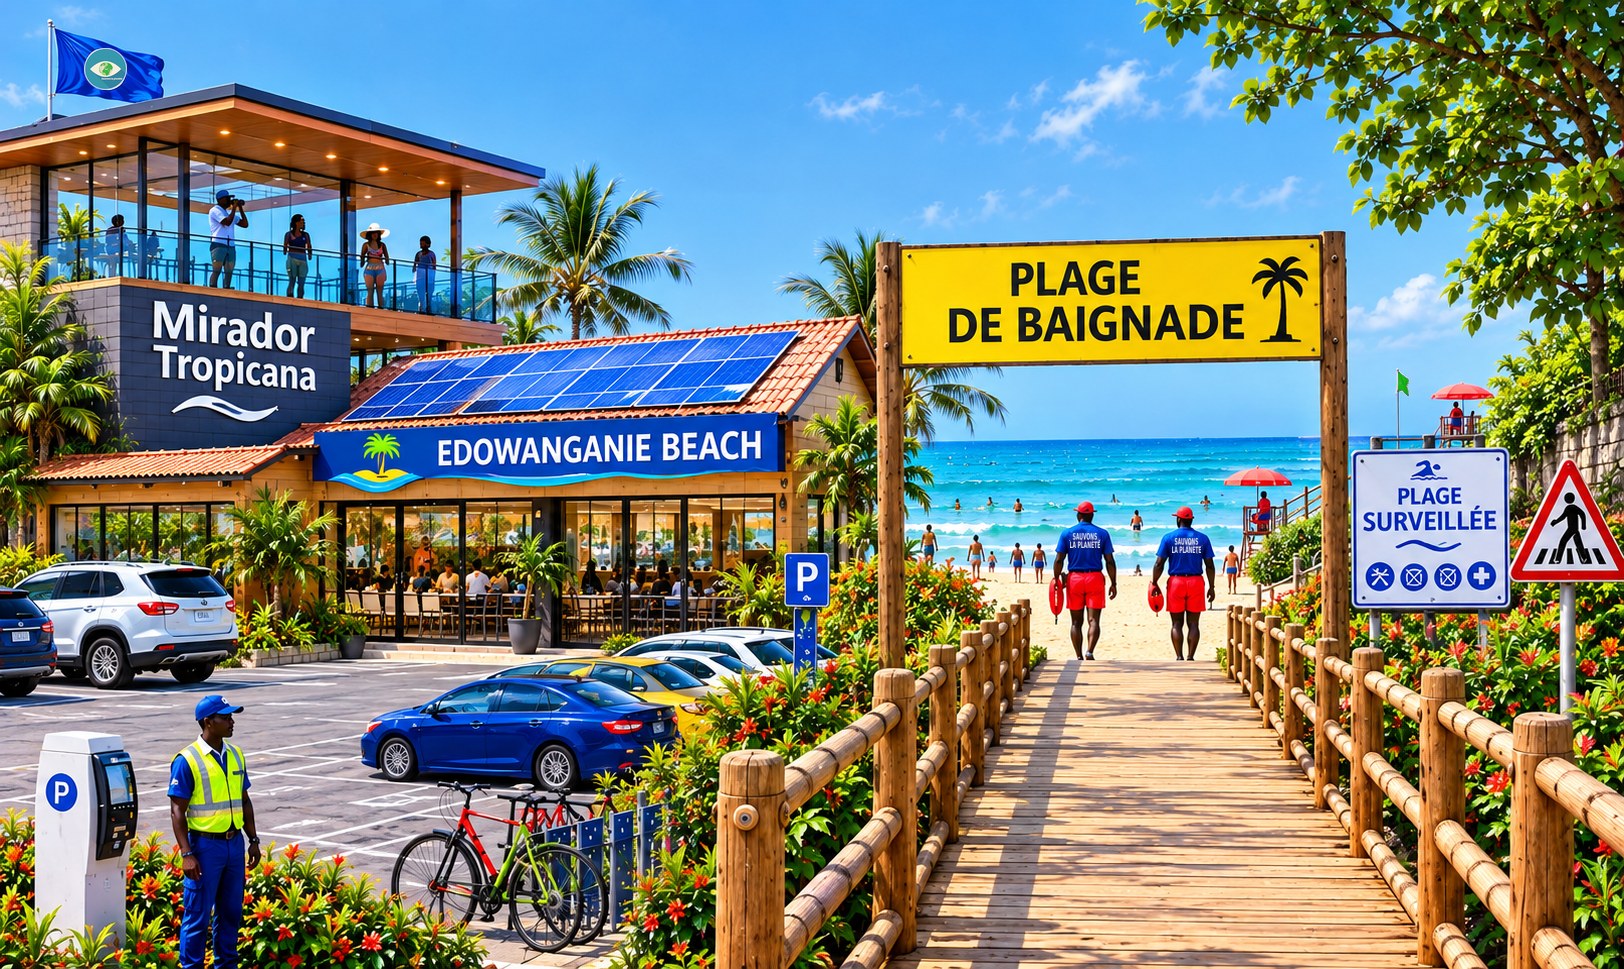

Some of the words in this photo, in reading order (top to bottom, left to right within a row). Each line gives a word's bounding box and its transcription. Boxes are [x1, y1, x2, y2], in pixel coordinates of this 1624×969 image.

[1011, 259, 1140, 296] PLAGE
[153, 300, 315, 354] Mirador
[949, 307, 1002, 343] DE
[1018, 303, 1245, 342] BAIGNADE
[153, 343, 317, 392] Tropicana
[437, 432, 651, 468] EDOWANGANIE
[662, 429, 762, 462] BEACH
[1397, 486, 1462, 506] PLAGE
[1363, 505, 1497, 532] SURVEILLÉE
[1069, 541, 1077, 549] LA
[1072, 532, 1098, 541] SAUVONS
[1171, 546, 1179, 554] LA
[1174, 537, 1199, 546] SAUVONS
[797, 562, 819, 592] P
[54, 780, 70, 805] P
